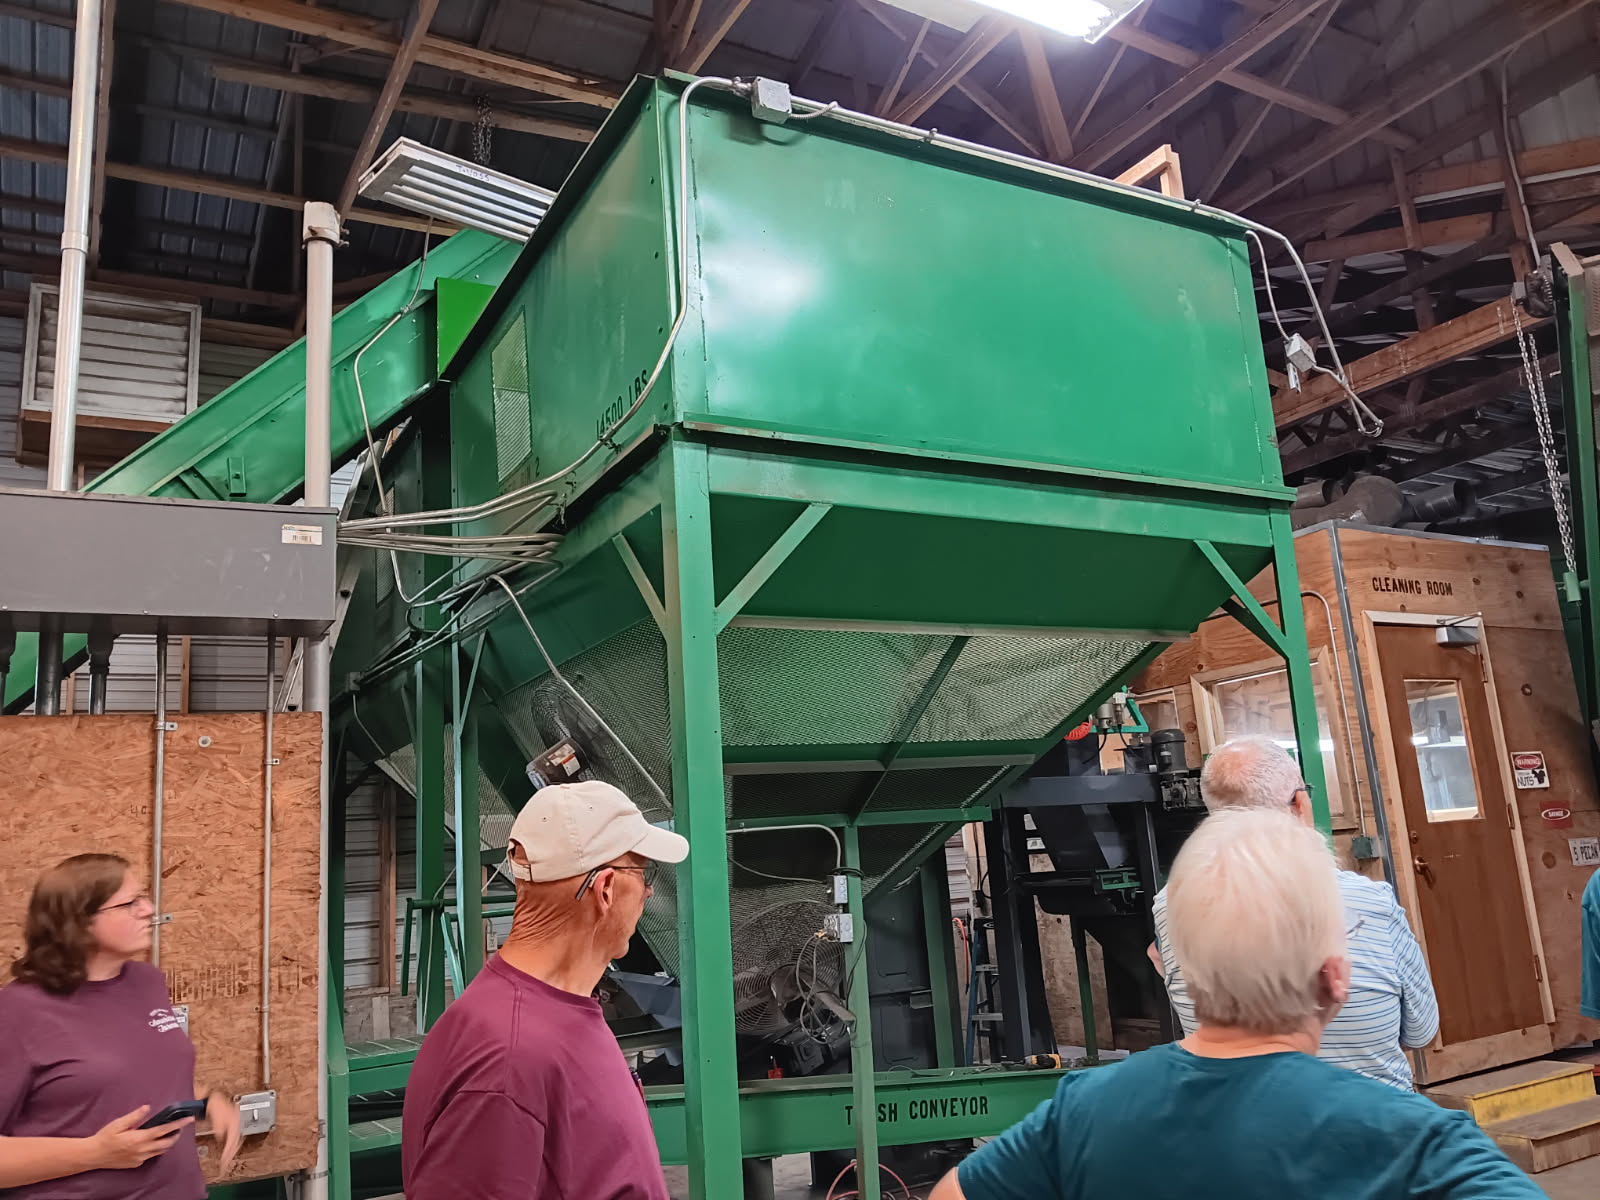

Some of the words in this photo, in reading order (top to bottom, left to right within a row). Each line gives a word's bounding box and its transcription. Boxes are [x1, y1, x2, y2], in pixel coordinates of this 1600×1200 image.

[1372, 577, 1422, 595] CLEANING
[1426, 580, 1453, 596] ROOM
[1517, 776, 1534, 787] NUTS
[845, 1103, 898, 1125] TSH
[909, 1096, 988, 1119] CONVEYOR
